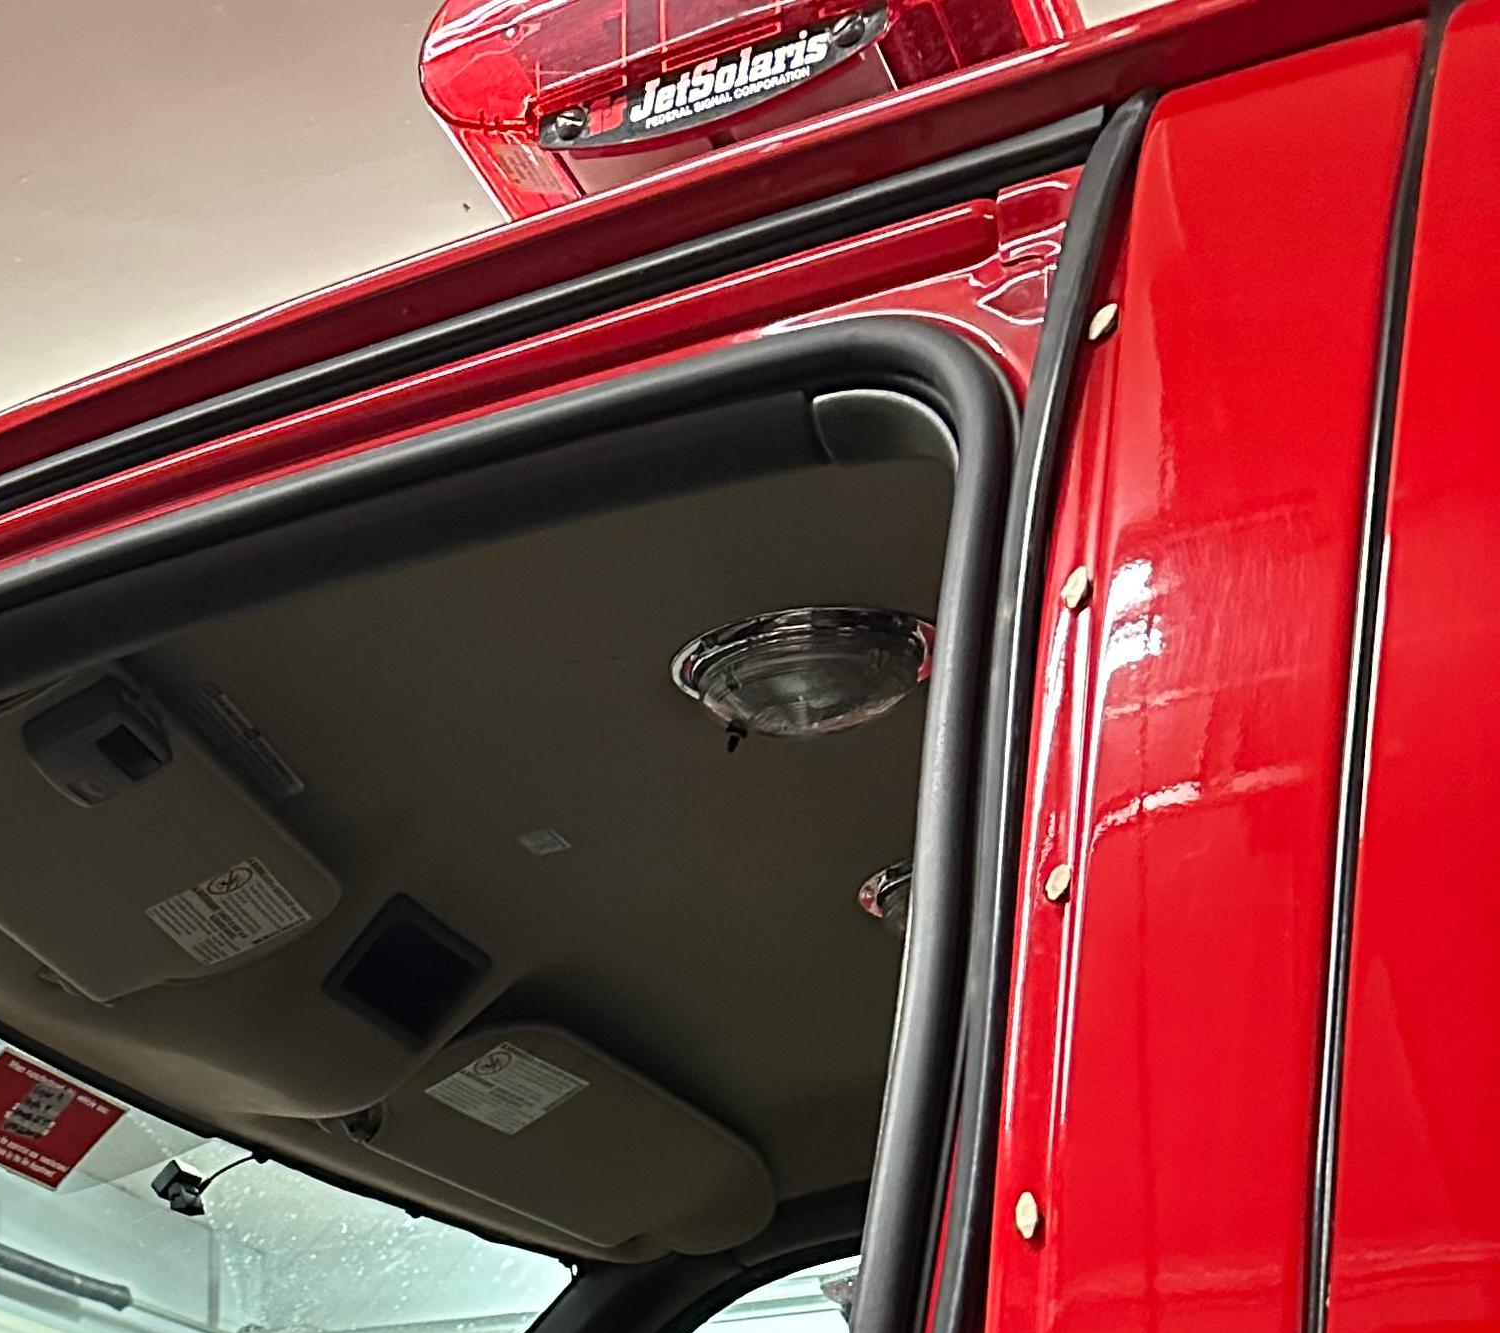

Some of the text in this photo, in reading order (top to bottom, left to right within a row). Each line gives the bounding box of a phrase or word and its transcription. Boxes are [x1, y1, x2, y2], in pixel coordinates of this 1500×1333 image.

[629, 29, 830, 123] JetSolaris
[645, 65, 811, 129] FEDERAL SIGNAL CORPORATION
